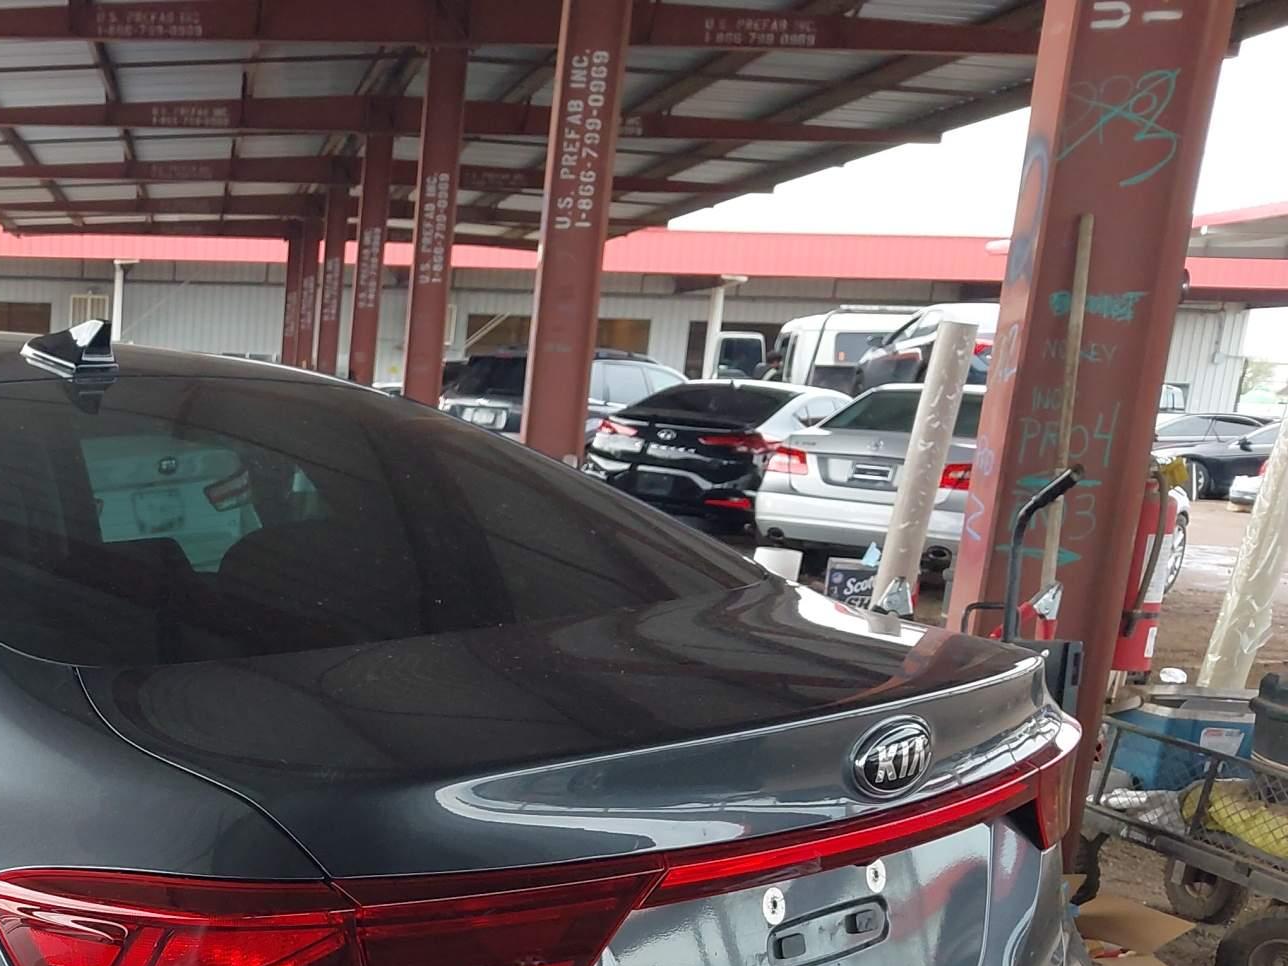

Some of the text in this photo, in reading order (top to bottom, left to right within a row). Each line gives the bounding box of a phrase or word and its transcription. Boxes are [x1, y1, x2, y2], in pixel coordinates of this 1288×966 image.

[554, 48, 591, 230] U.S. PREFAB INC.
[574, 50, 610, 228] 1-866-799-0969
